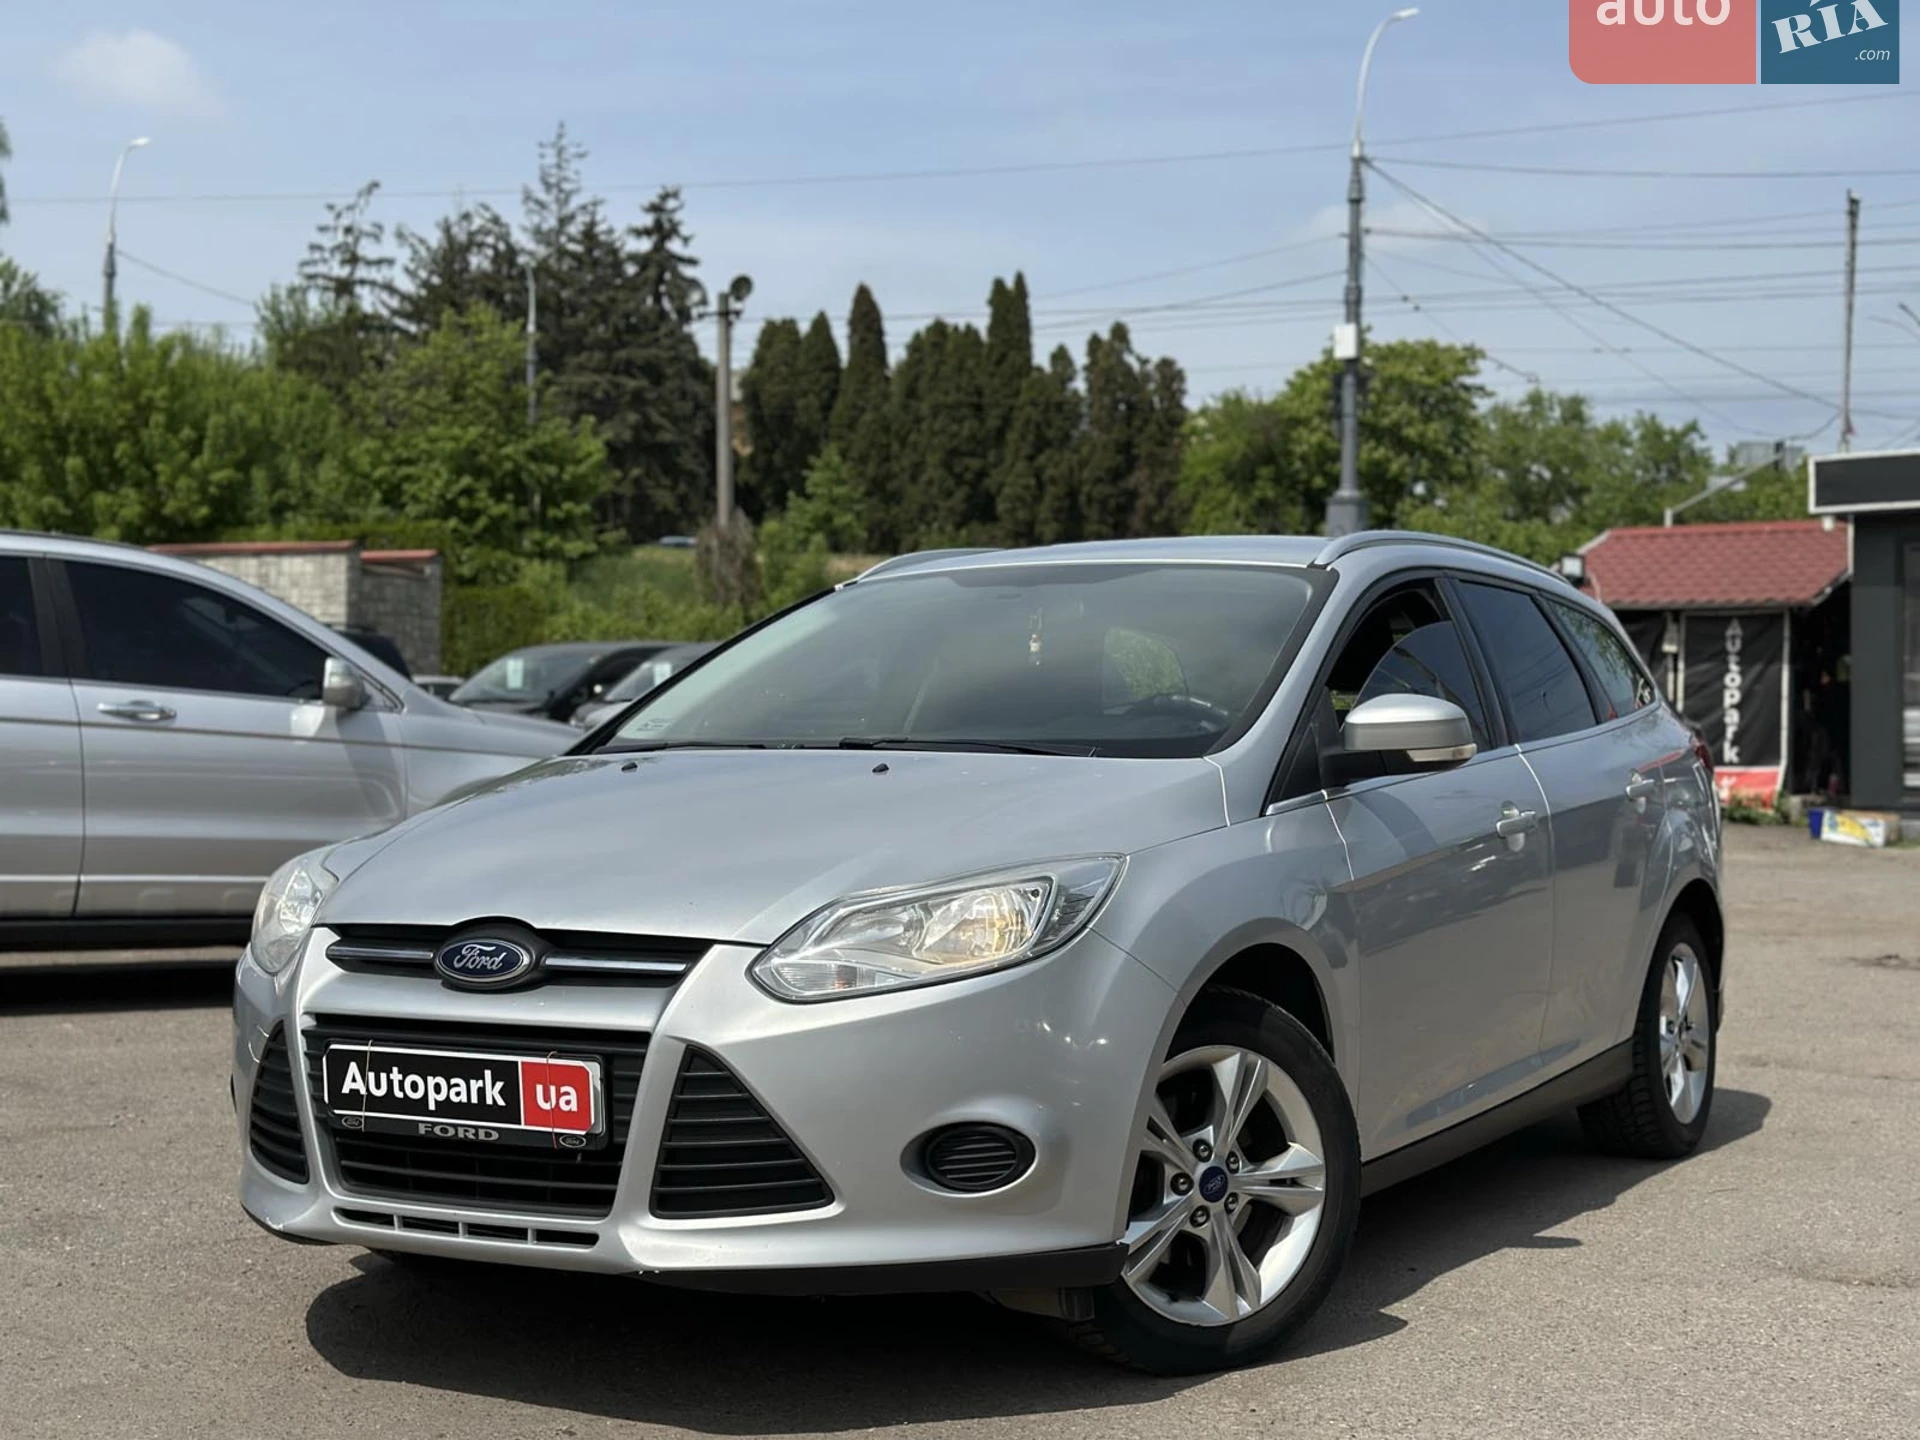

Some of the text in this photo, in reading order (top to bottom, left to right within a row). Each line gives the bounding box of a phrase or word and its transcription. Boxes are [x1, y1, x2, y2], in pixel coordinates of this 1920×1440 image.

[1723, 617, 1742, 763] Autopark
[453, 943, 507, 971] Ford
[341, 1061, 578, 1112] Autopark ua
[418, 1122, 499, 1141] FORD
